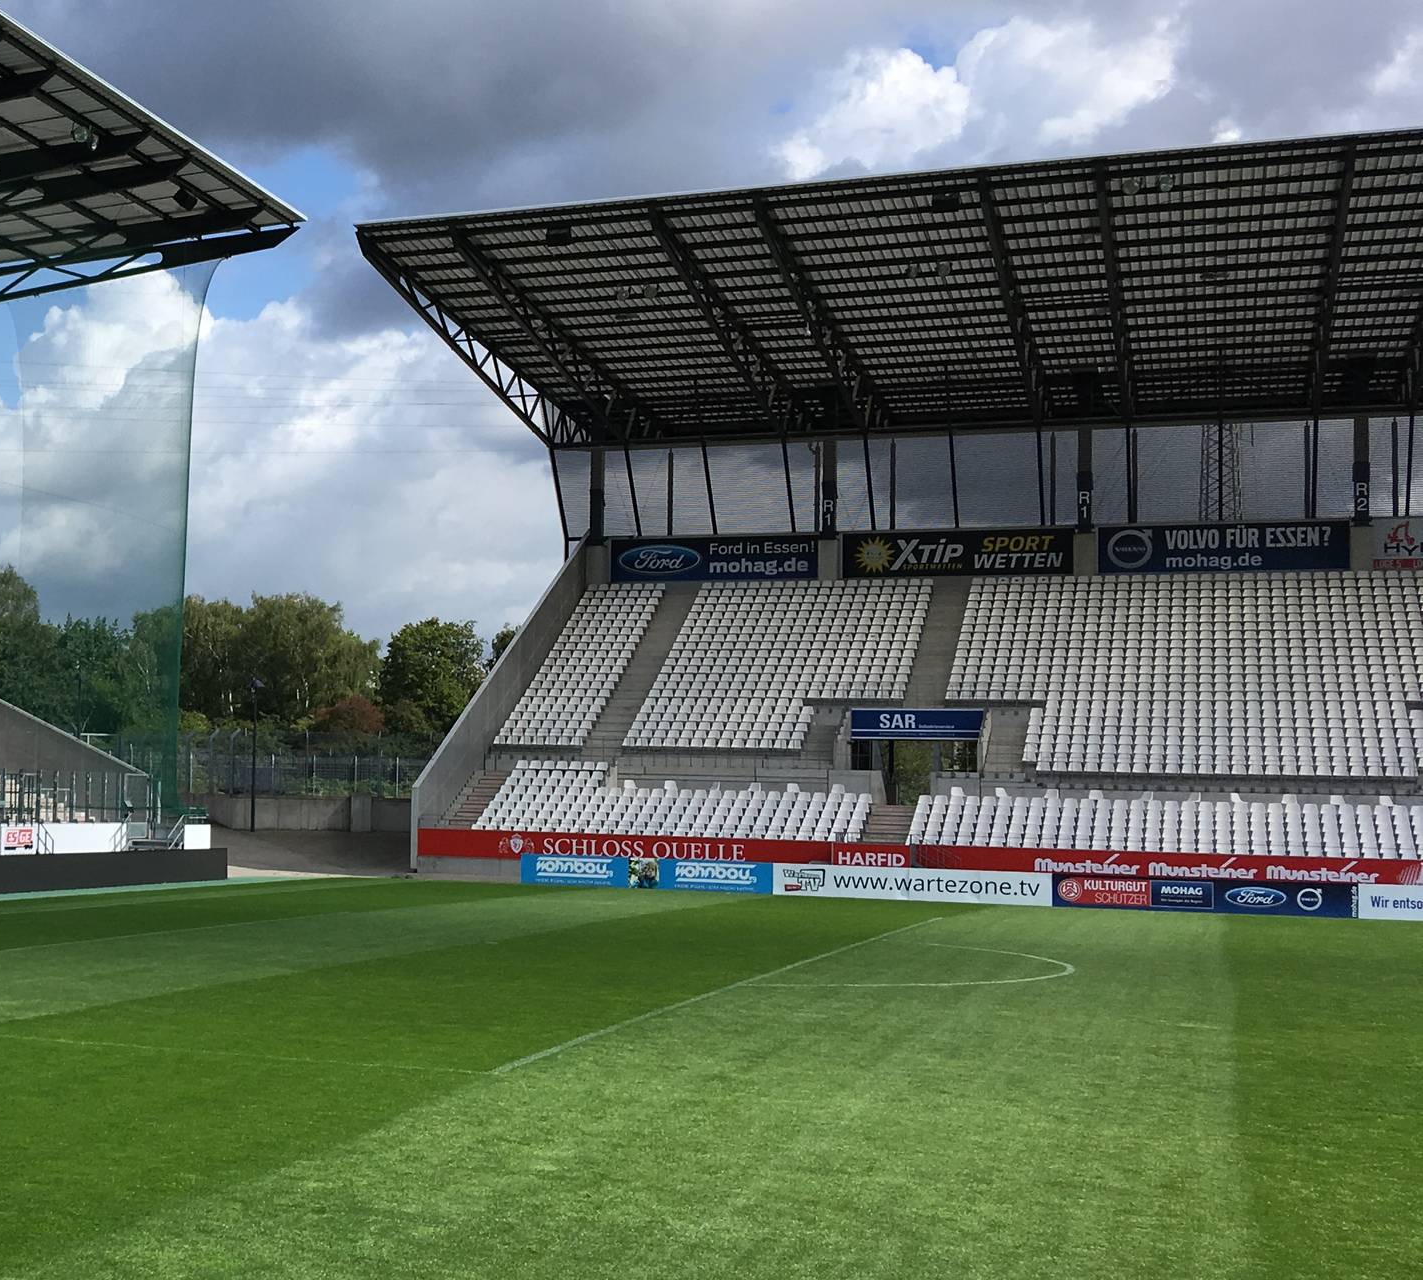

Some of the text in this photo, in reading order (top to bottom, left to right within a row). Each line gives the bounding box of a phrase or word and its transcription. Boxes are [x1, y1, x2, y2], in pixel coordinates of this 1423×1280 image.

[981, 536, 1054, 553] SPORT
[1165, 525, 1332, 550] VOLVO FÜR ESSEN?
[709, 543, 743, 555] Ford
[747, 542, 760, 555] in
[1384, 541, 1423, 556] HY
[634, 549, 685, 570] Ford
[709, 557, 808, 575] mohag.de
[974, 552, 1063, 568] WETTEN
[1165, 553, 1262, 569] mohag.de
[879, 713, 916, 728] SAR
[542, 838, 644, 858] SCHLOSS
[837, 851, 906, 867] HARFID
[1034, 854, 1380, 883] Munsteiner Munsteiner Munsteiner
[833, 873, 1040, 897] www.wartezone.tv
[1084, 880, 1148, 892] KULTURGUT
[1161, 886, 1203, 896] MOHAG
[1236, 889, 1275, 906] Ford
[1370, 895, 1389, 907] Wir
